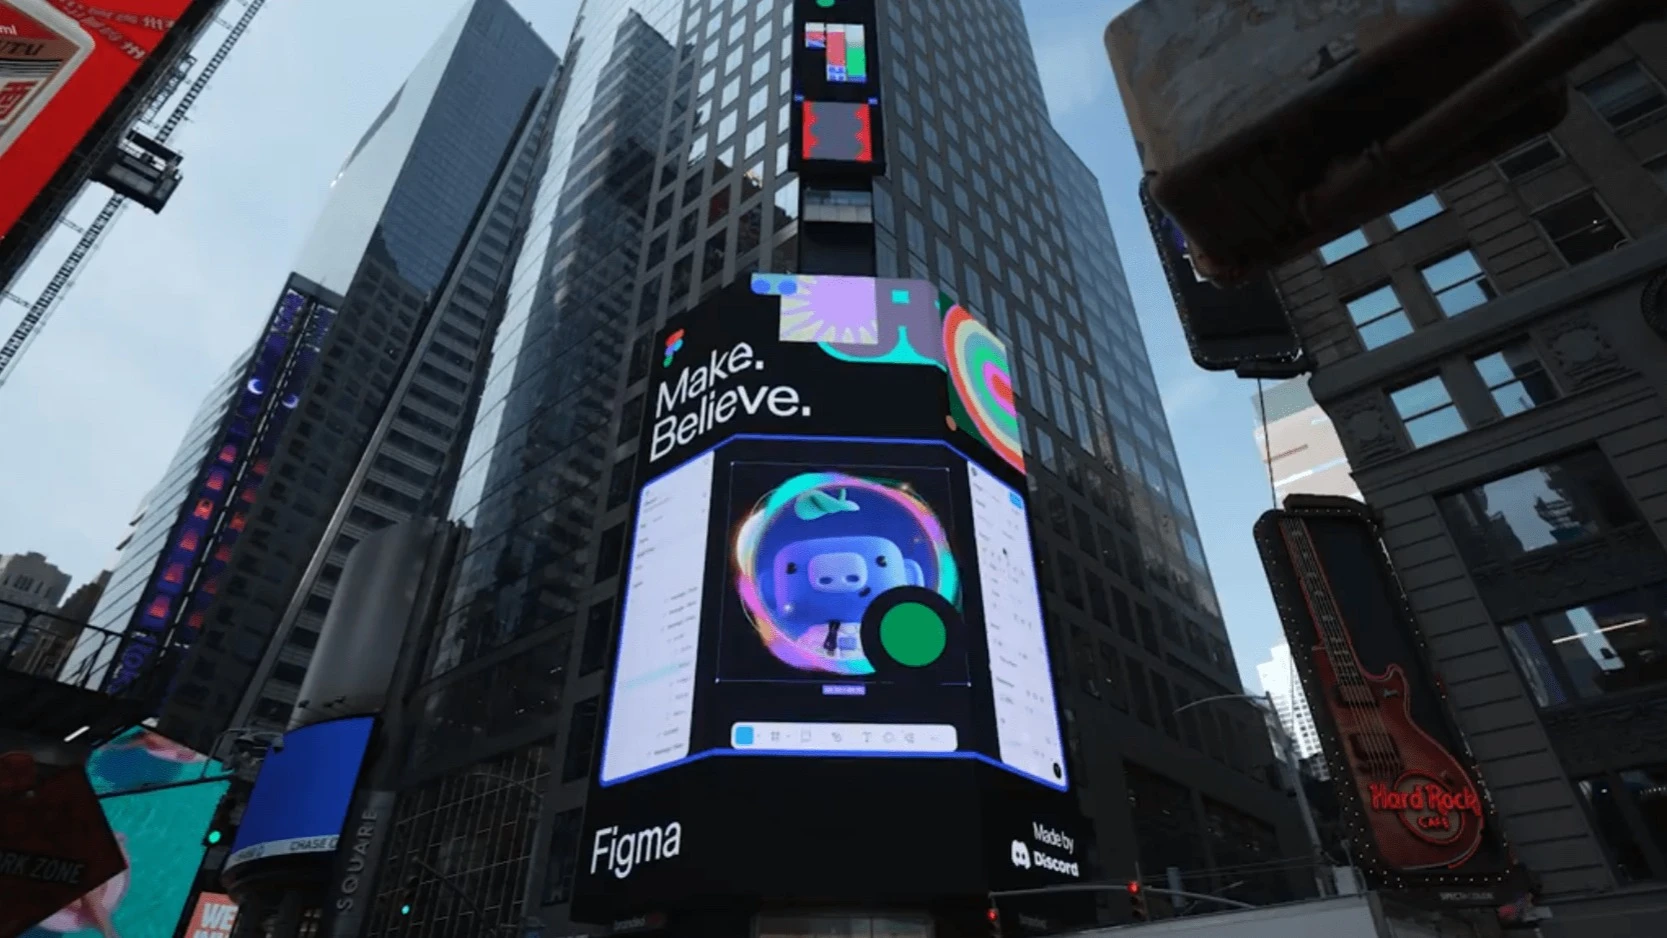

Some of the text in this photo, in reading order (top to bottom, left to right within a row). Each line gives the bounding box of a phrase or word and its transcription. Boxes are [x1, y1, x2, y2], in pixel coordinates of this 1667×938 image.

[655, 342, 764, 419] Make.
[650, 385, 811, 463] Believe.
[1370, 783, 1480, 817] Hard Rock
[590, 822, 681, 879] Figma
[1032, 821, 1074, 855] Made by
[29, 857, 85, 885] ZONE
[336, 809, 377, 911] SQUARE
[1033, 850, 1079, 878] Discord
[201, 903, 239, 931] WE
